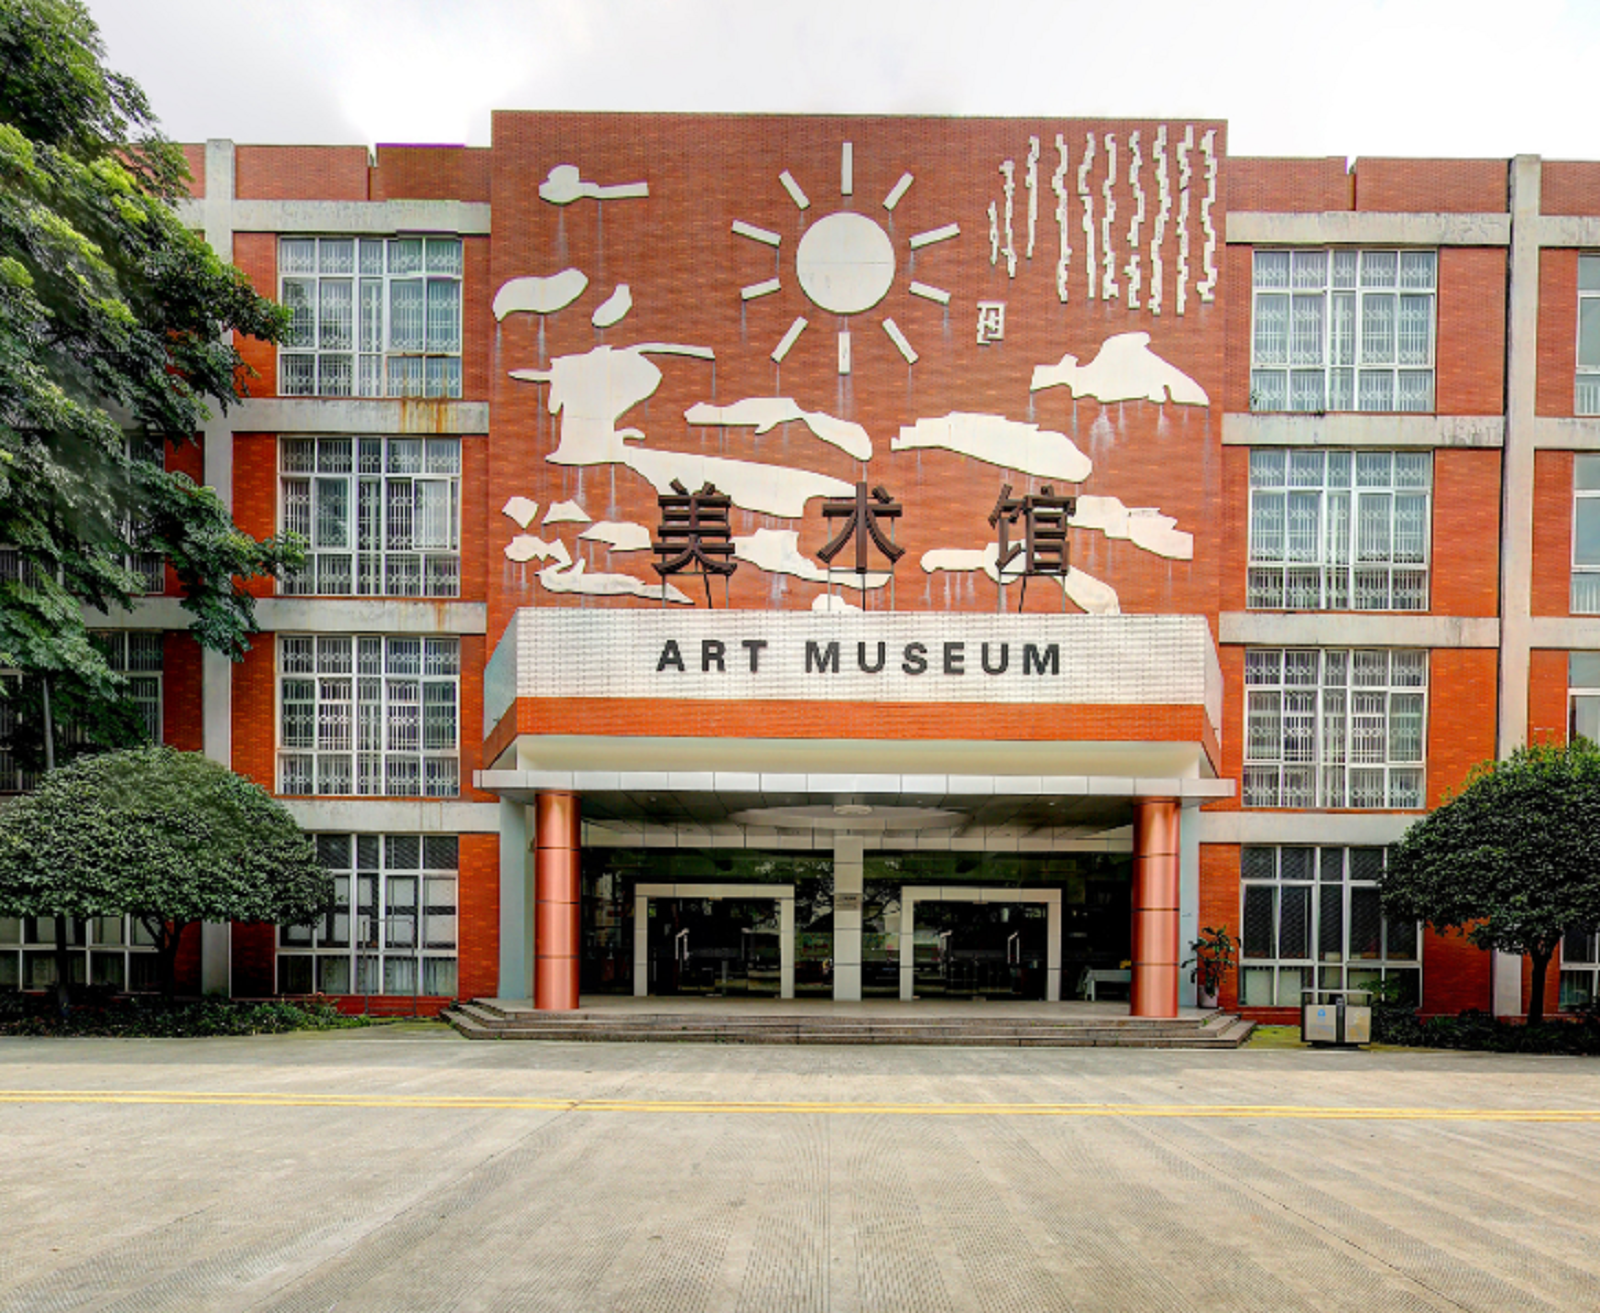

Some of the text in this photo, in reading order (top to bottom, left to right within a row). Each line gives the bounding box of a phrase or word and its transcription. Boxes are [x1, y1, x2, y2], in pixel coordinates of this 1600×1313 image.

[651, 478, 1077, 576] 美术馆
[656, 639, 1060, 676] ART MUSEUM
